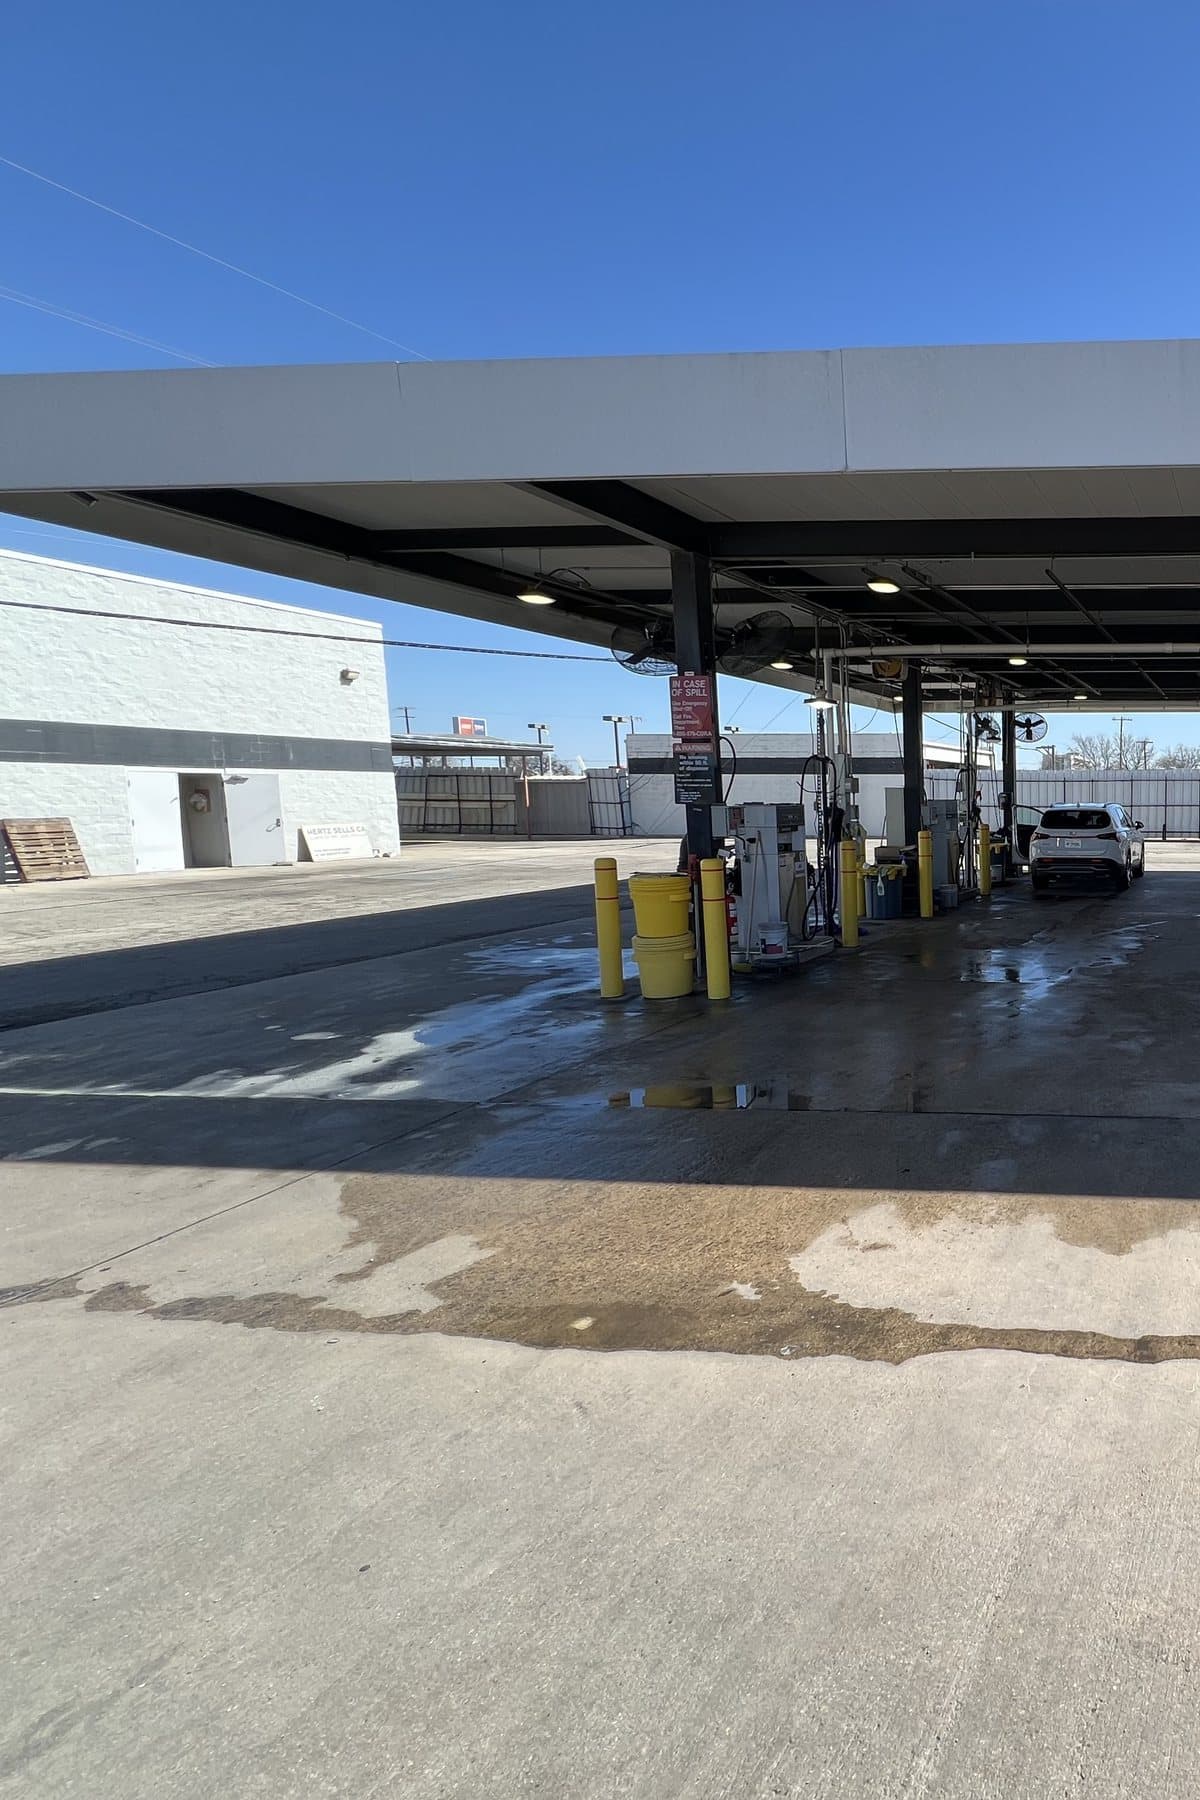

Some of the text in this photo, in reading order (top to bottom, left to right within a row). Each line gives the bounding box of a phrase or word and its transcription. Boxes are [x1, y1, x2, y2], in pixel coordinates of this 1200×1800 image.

[672, 680, 706, 688] IN CASE
[672, 688, 708, 697] OF SPILL
[307, 827, 332, 835] HERTZ
[333, 826, 356, 834] SELLS
